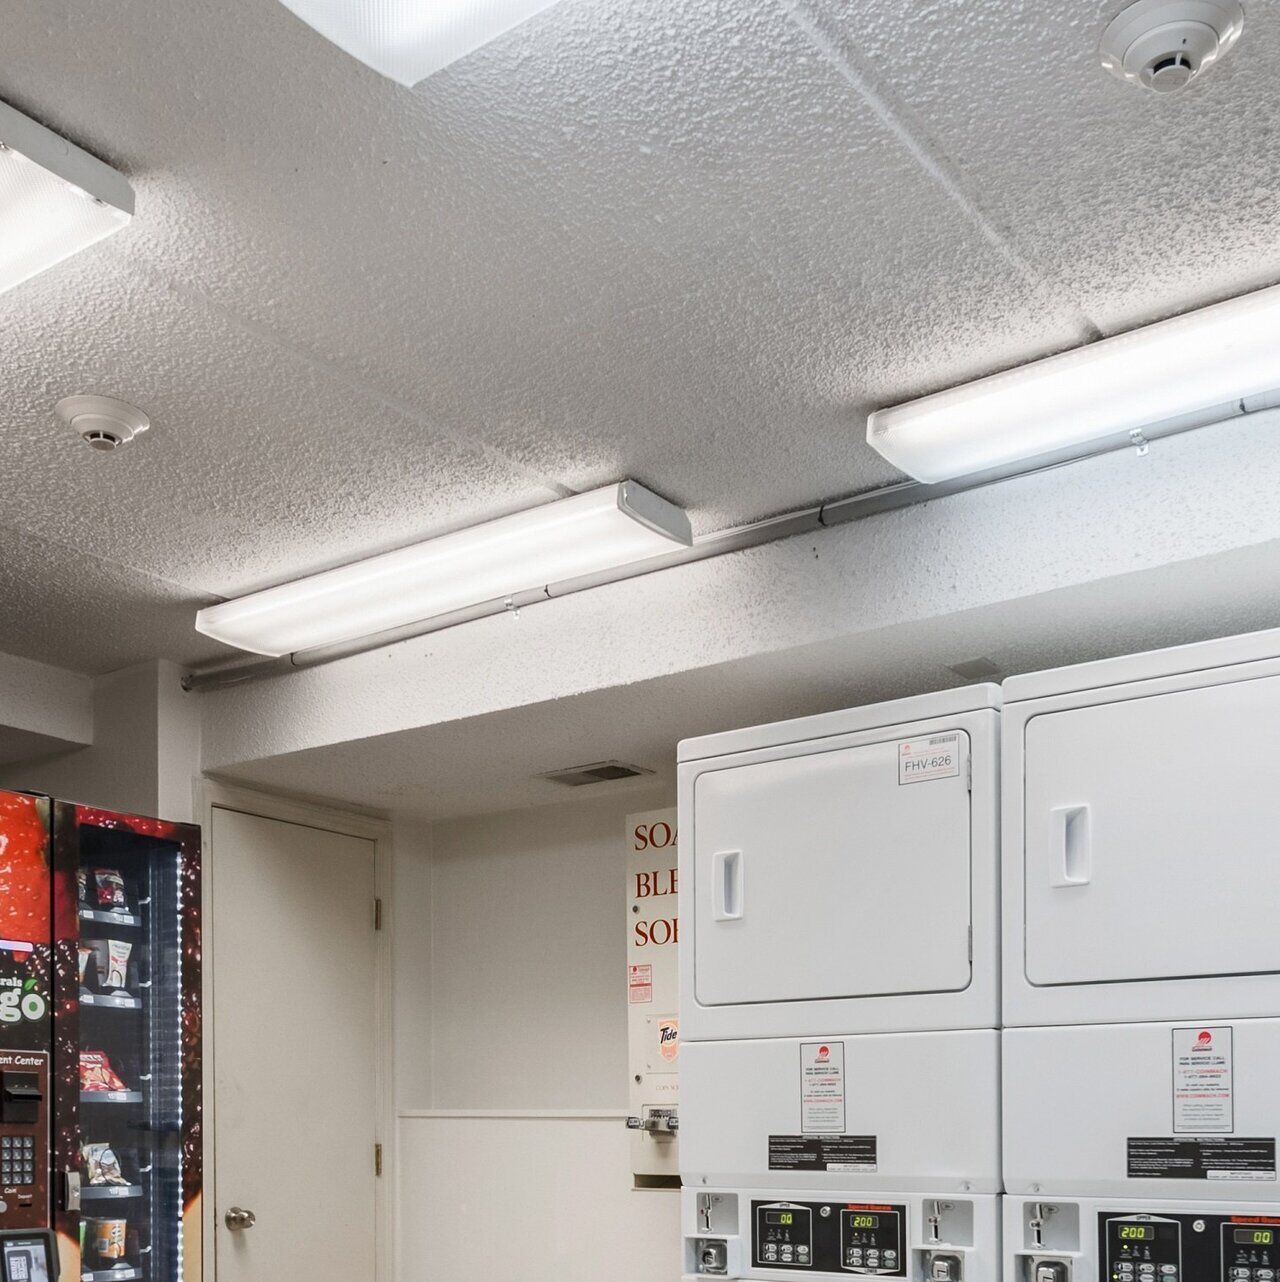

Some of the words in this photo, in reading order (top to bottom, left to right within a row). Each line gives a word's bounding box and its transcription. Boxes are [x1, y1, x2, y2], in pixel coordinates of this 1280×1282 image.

[904, 755, 952, 772] FHV-626
[660, 1026, 678, 1044] Tide
[15, 1055, 44, 1066] Center
[853, 1216, 873, 1227] 200
[1230, 1215, 1260, 1224] Speed
[1122, 1227, 1145, 1238] 200
[1254, 1232, 1270, 1243] 00
